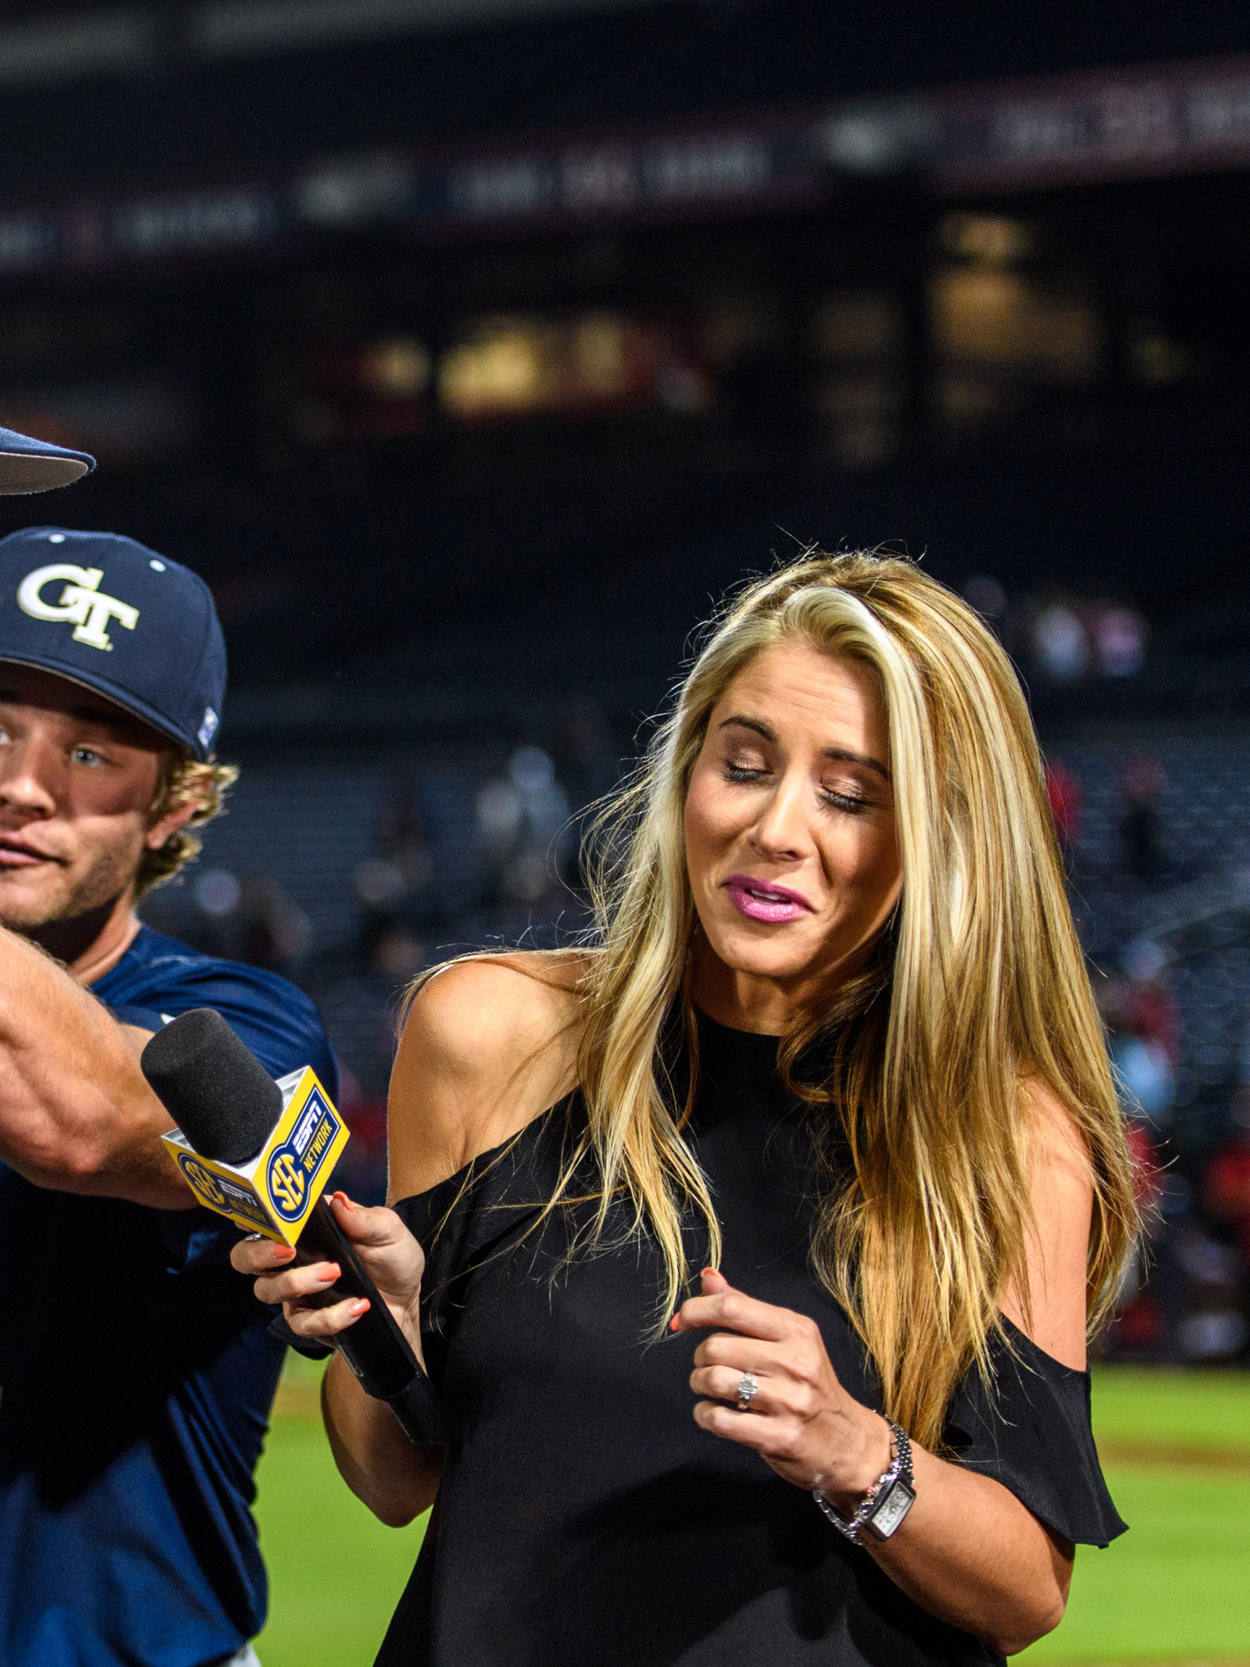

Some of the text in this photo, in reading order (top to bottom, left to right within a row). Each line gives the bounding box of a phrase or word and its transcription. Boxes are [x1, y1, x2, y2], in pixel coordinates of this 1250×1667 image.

[17, 563, 140, 651] GT
[292, 1100, 322, 1156] ESPN
[303, 1118, 333, 1173] NETWORK
[185, 1161, 225, 1205] SEC
[271, 1153, 305, 1211] SEC
